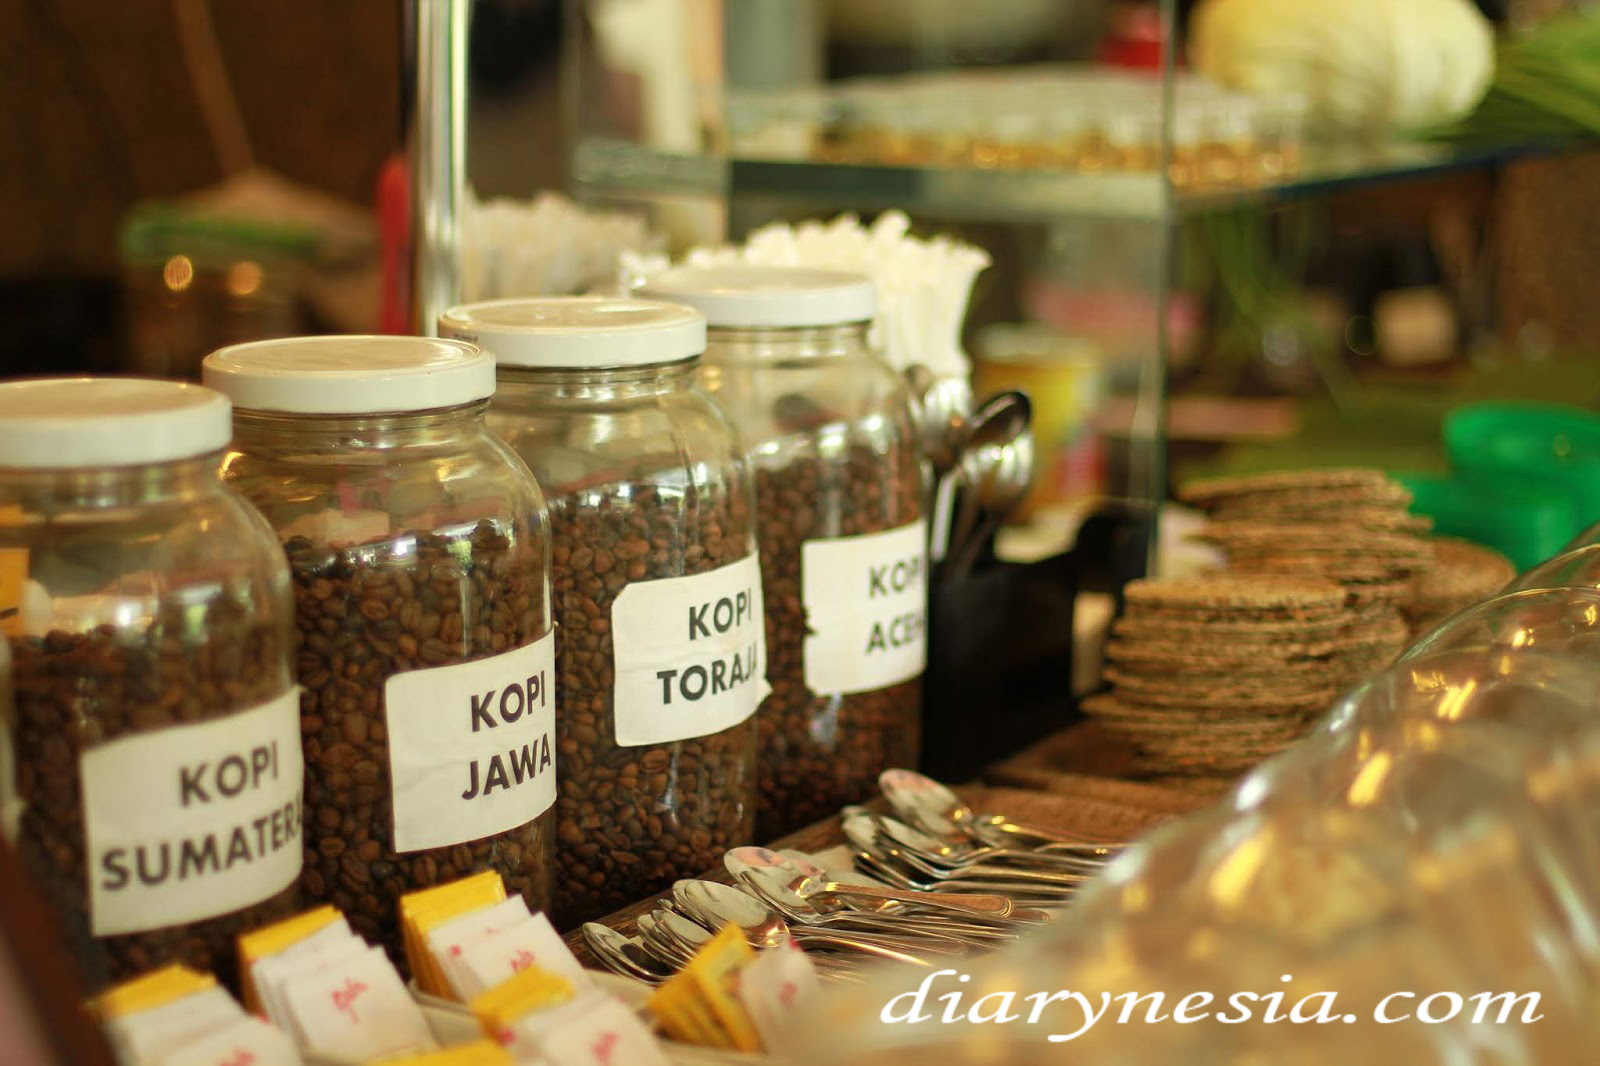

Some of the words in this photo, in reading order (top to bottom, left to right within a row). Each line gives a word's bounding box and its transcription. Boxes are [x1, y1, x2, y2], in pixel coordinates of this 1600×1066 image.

[689, 587, 752, 640] KOPI
[471, 670, 546, 732] KOPI
[179, 740, 279, 808] KOPI
[461, 733, 551, 800] JAWA
